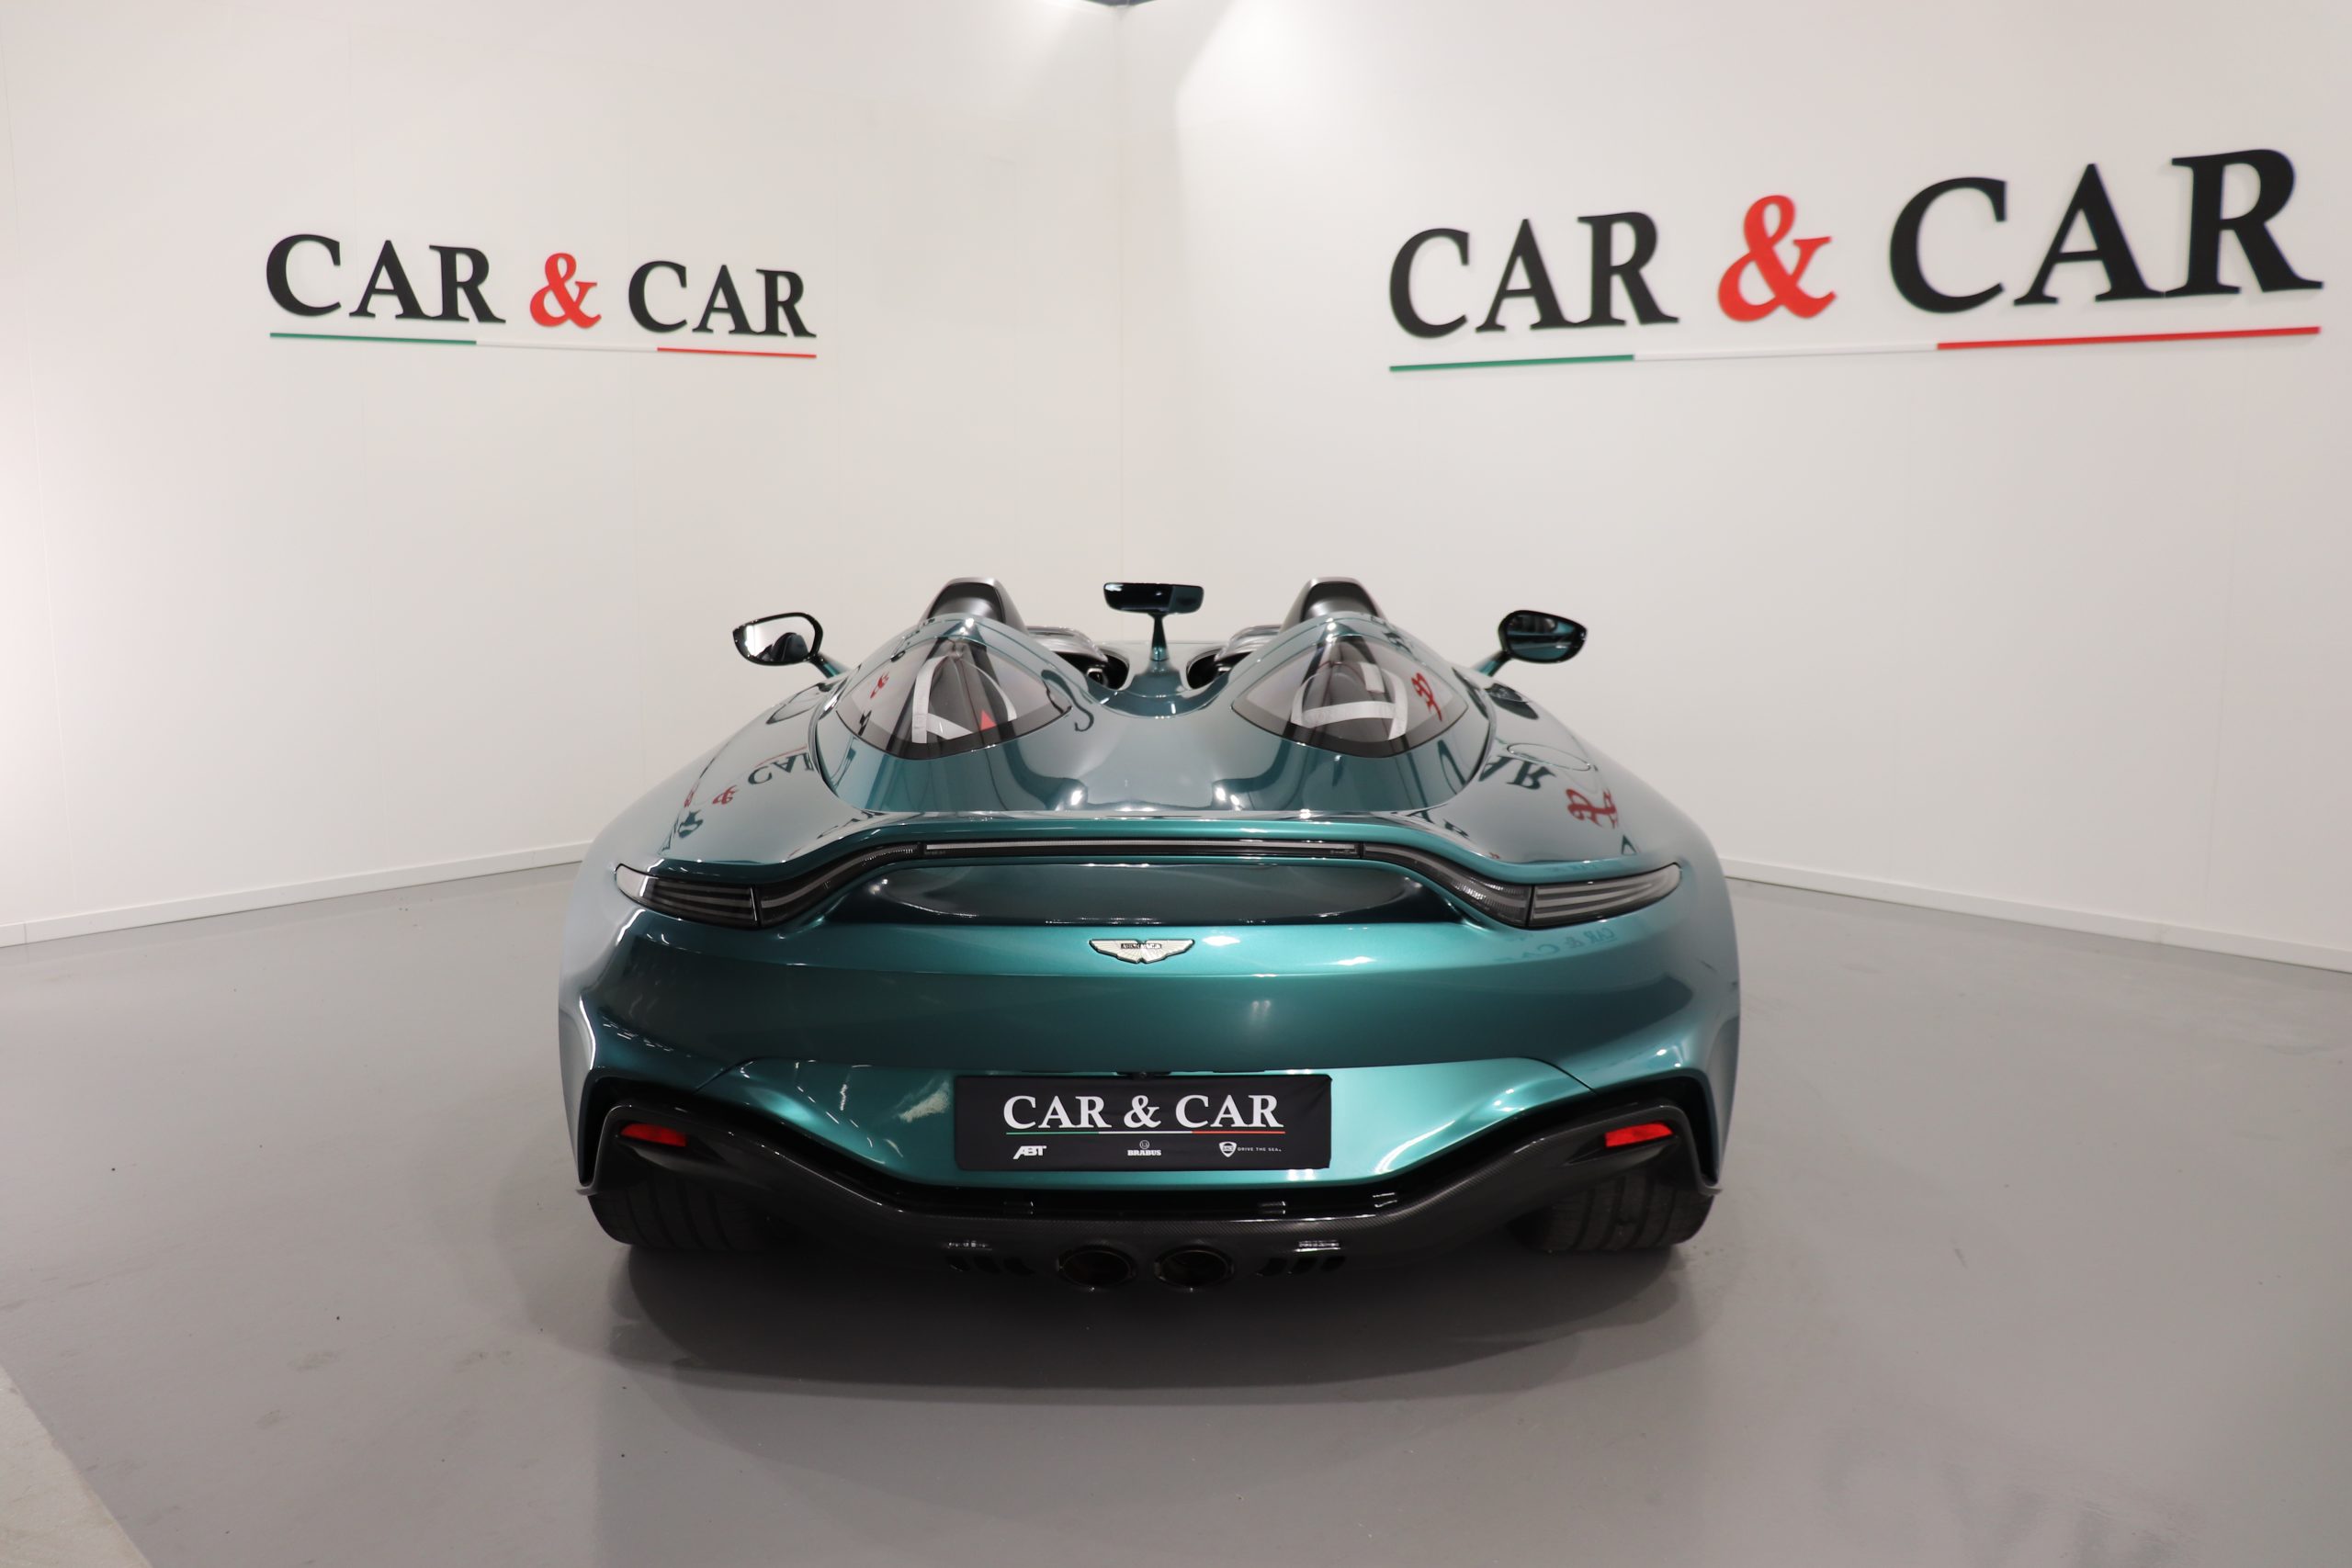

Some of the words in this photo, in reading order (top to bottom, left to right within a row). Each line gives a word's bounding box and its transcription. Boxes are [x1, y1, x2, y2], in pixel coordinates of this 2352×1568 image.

[1388, 211, 1679, 338] CAR
[1717, 194, 1838, 322] &
[1888, 149, 2324, 314] CAR
[266, 233, 506, 323] CAR
[529, 253, 602, 328] &
[628, 260, 817, 338] CAR
[1003, 1095, 1112, 1129] CAR
[1124, 1095, 1161, 1129] &
[1175, 1094, 1284, 1129] CAR
[1013, 1145, 1047, 1160] ABT
